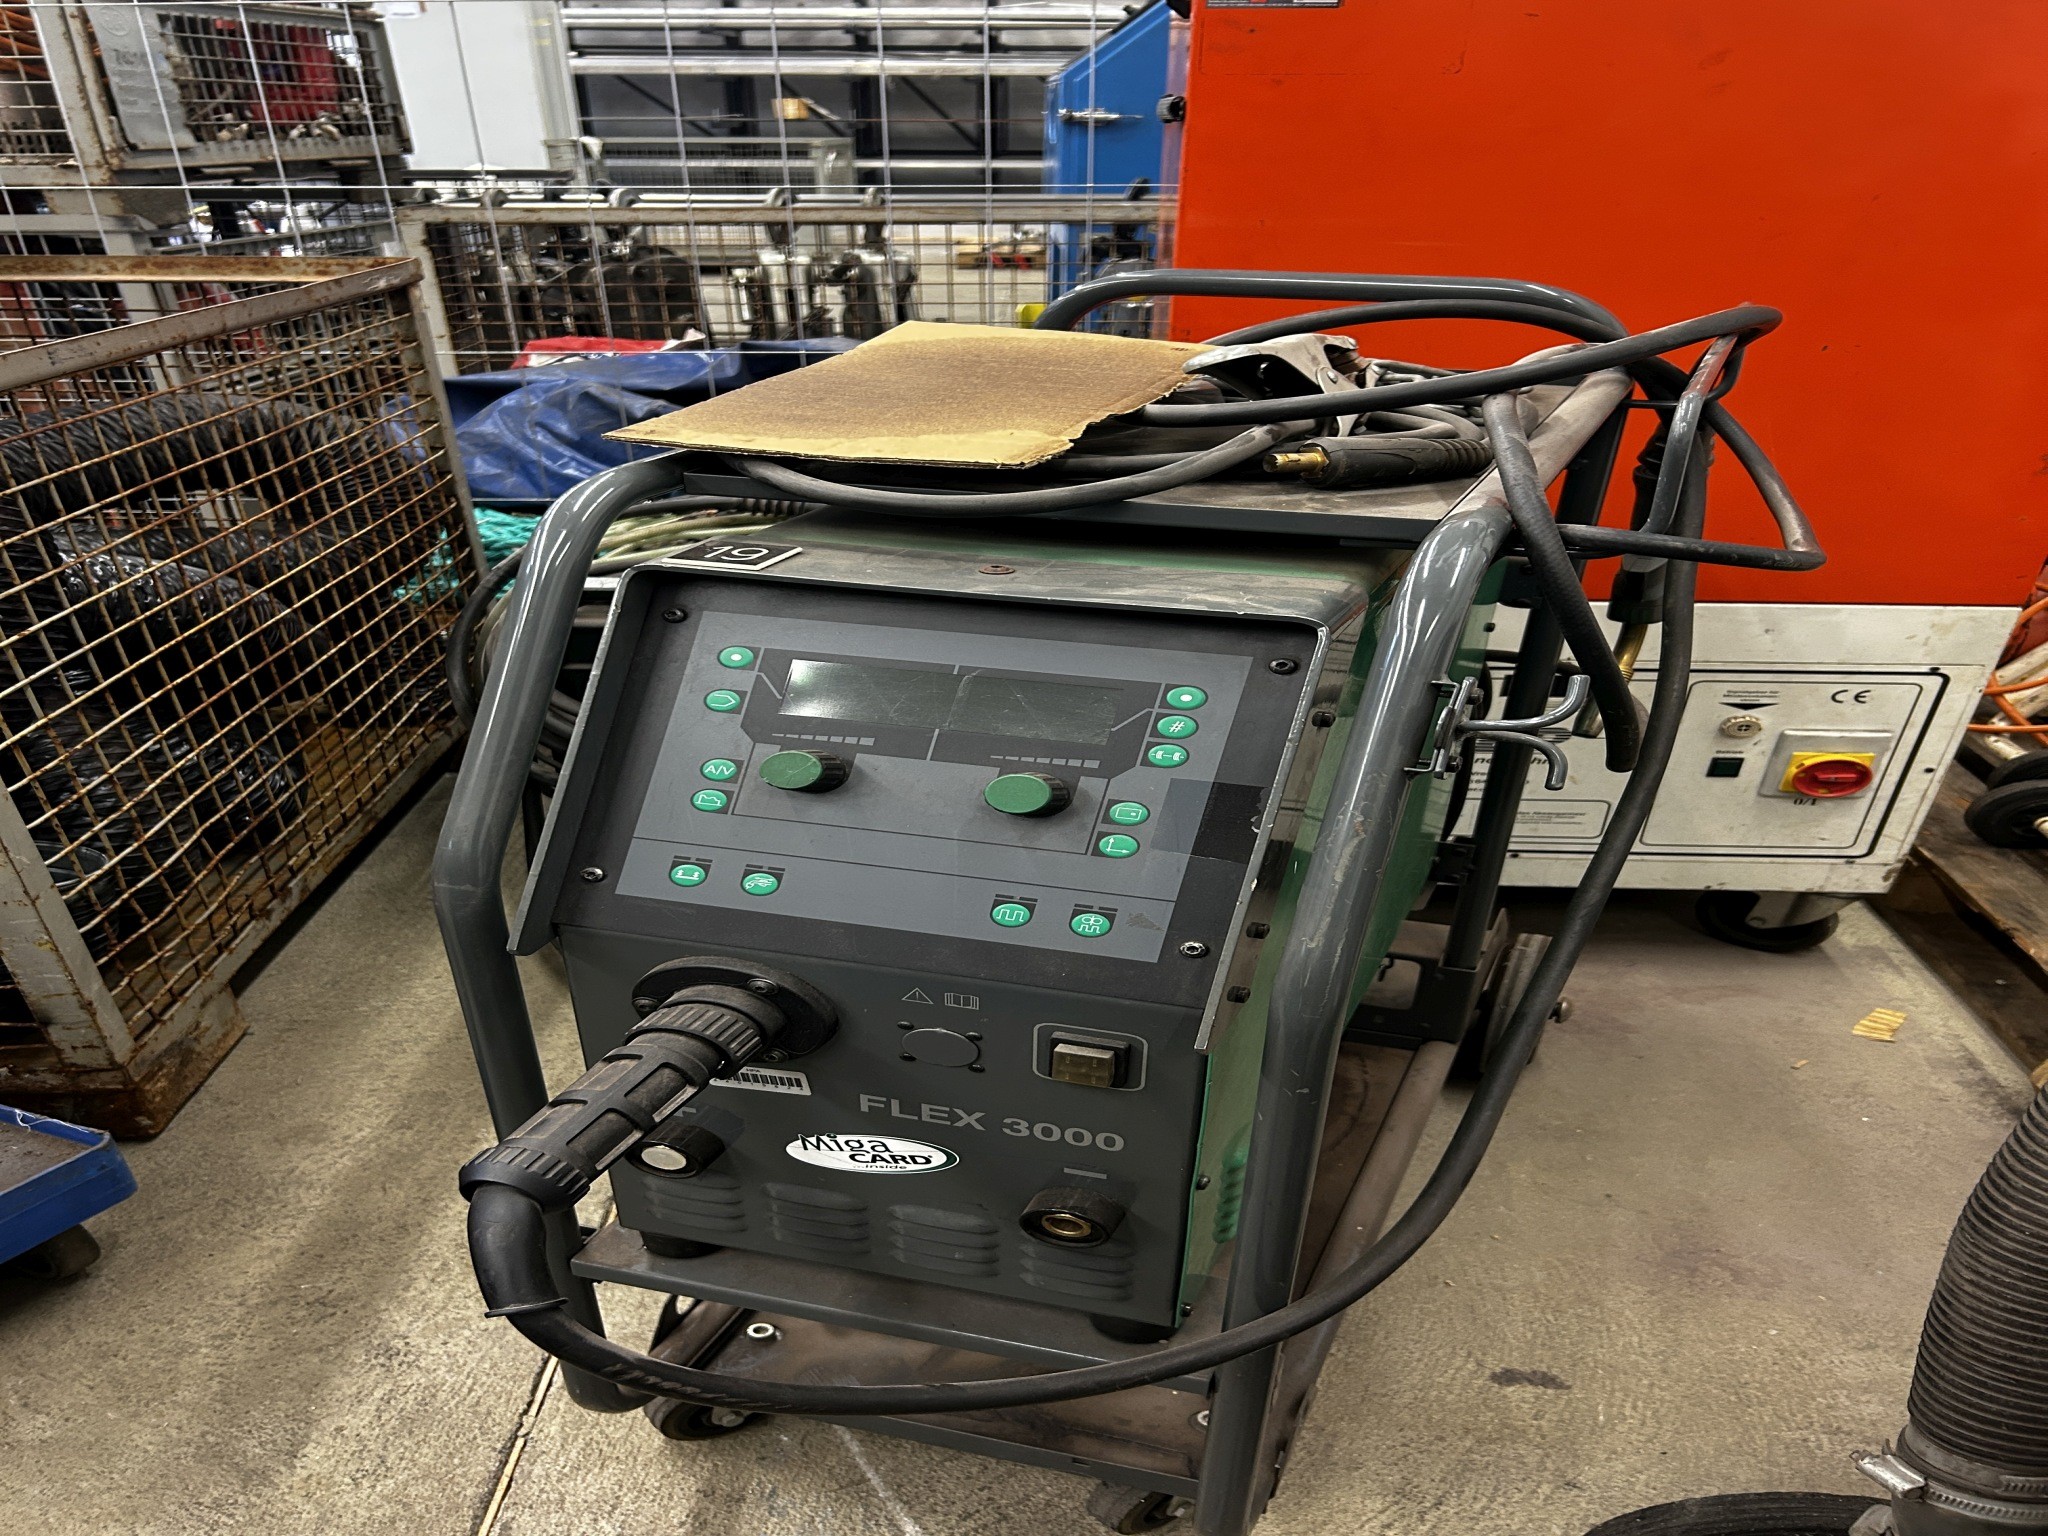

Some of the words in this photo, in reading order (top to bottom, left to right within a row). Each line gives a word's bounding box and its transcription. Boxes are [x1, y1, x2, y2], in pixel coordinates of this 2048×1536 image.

[703, 545, 770, 561] 19
[1830, 689, 1873, 705] CE
[704, 764, 735, 775] A/V
[859, 1093, 987, 1131] FLEX
[1001, 1117, 1125, 1152] 3000
[798, 1132, 894, 1154] Miga
